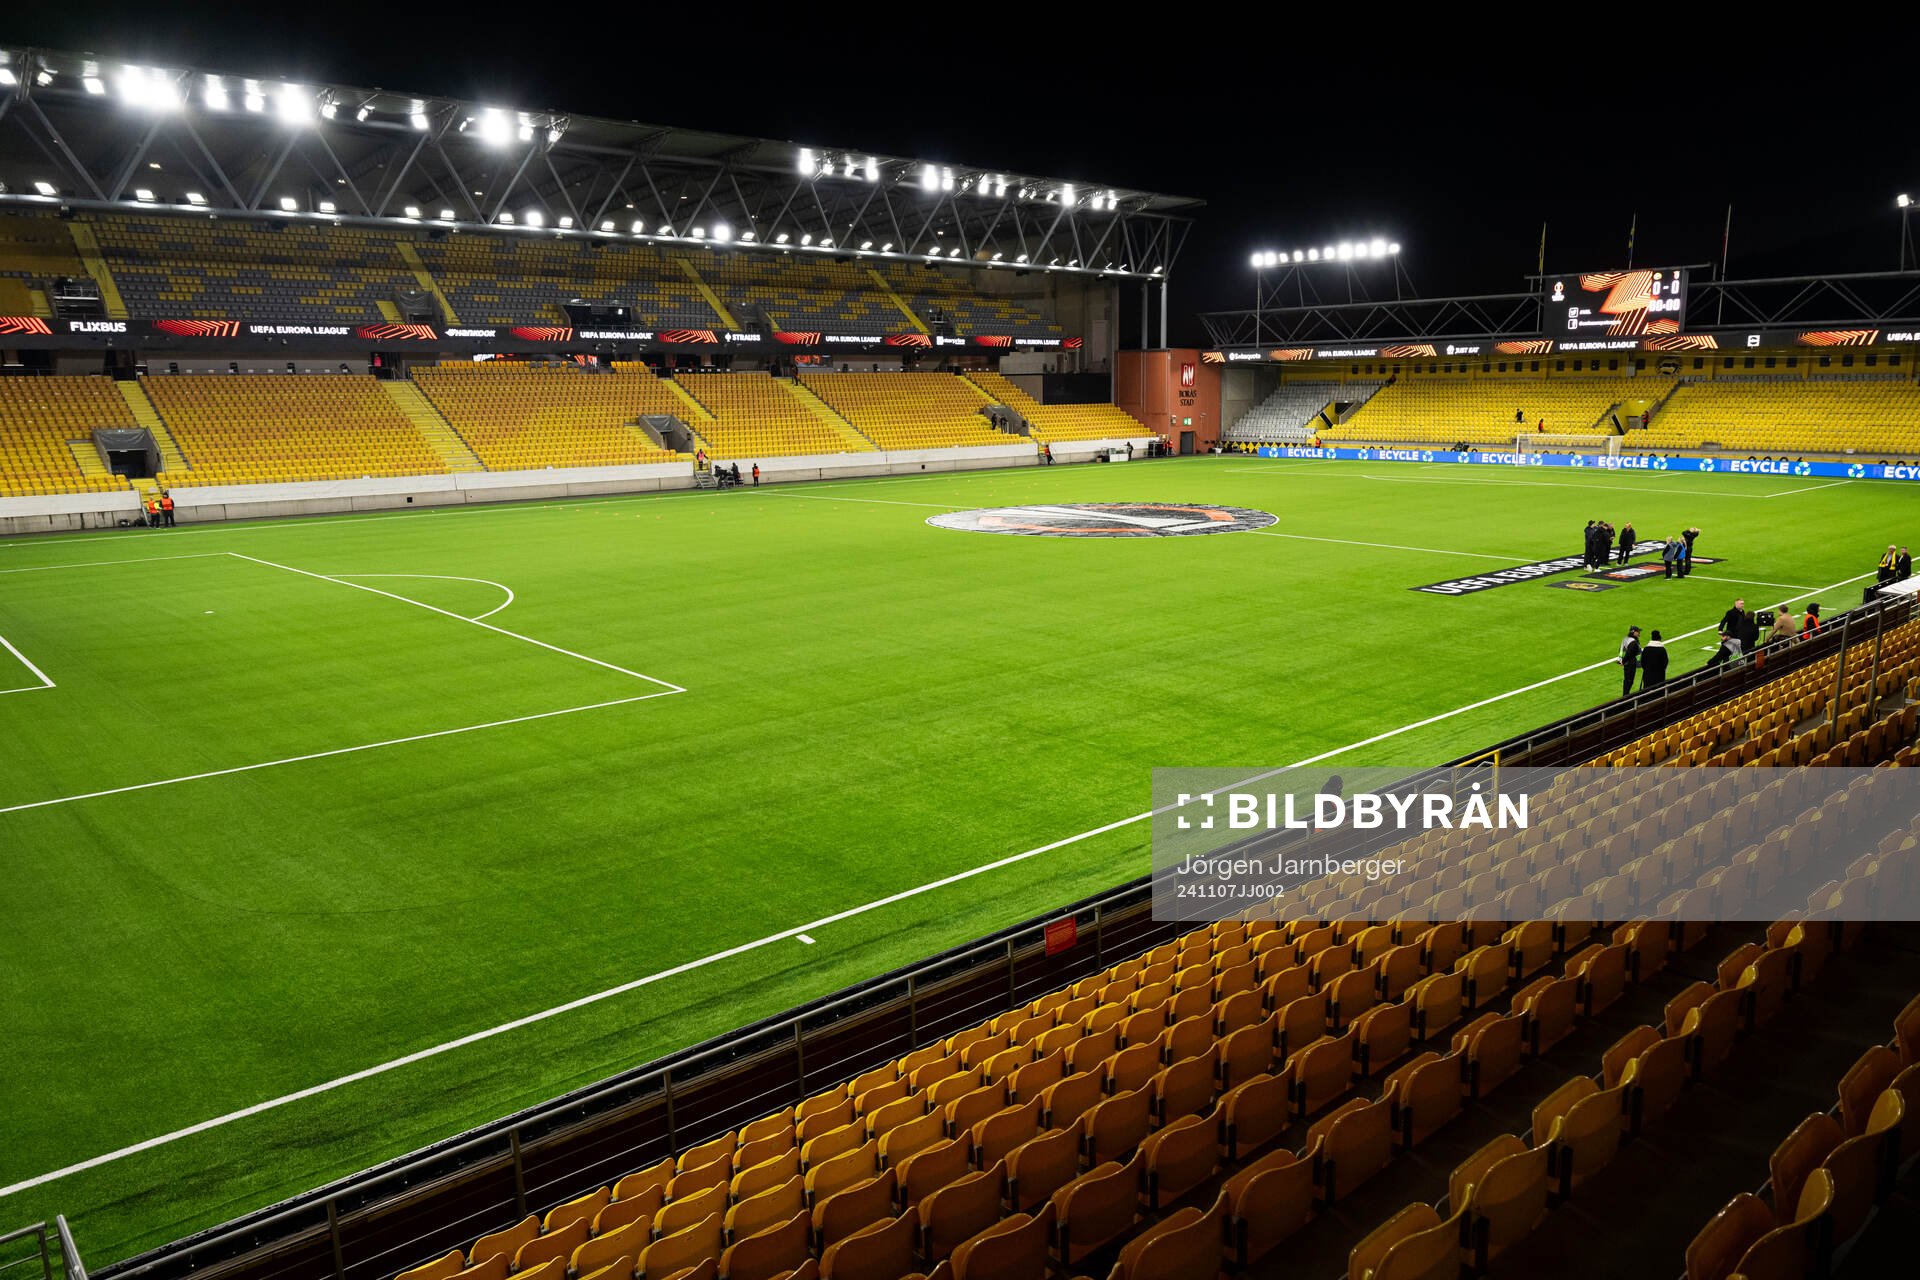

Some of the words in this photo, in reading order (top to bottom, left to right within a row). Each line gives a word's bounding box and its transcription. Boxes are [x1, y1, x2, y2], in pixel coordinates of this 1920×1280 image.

[1652, 281, 1661, 296] 0
[1671, 279, 1680, 294] 0
[70, 321, 127, 332] FLIXBUS
[250, 326, 276, 334] UEFA
[276, 326, 313, 334] EUROPA
[313, 327, 348, 335] LEAGUE
[580, 331, 599, 339] UEFA
[599, 331, 626, 339] EUROPA
[732, 333, 761, 341] STRAUSS
[1887, 333, 1913, 341] UEFA
[1560, 342, 1578, 350] UEFA
[1578, 341, 1607, 350] EUROPA
[1607, 341, 1636, 349] LEAGUE
[1420, 577, 1516, 594] UEFA
